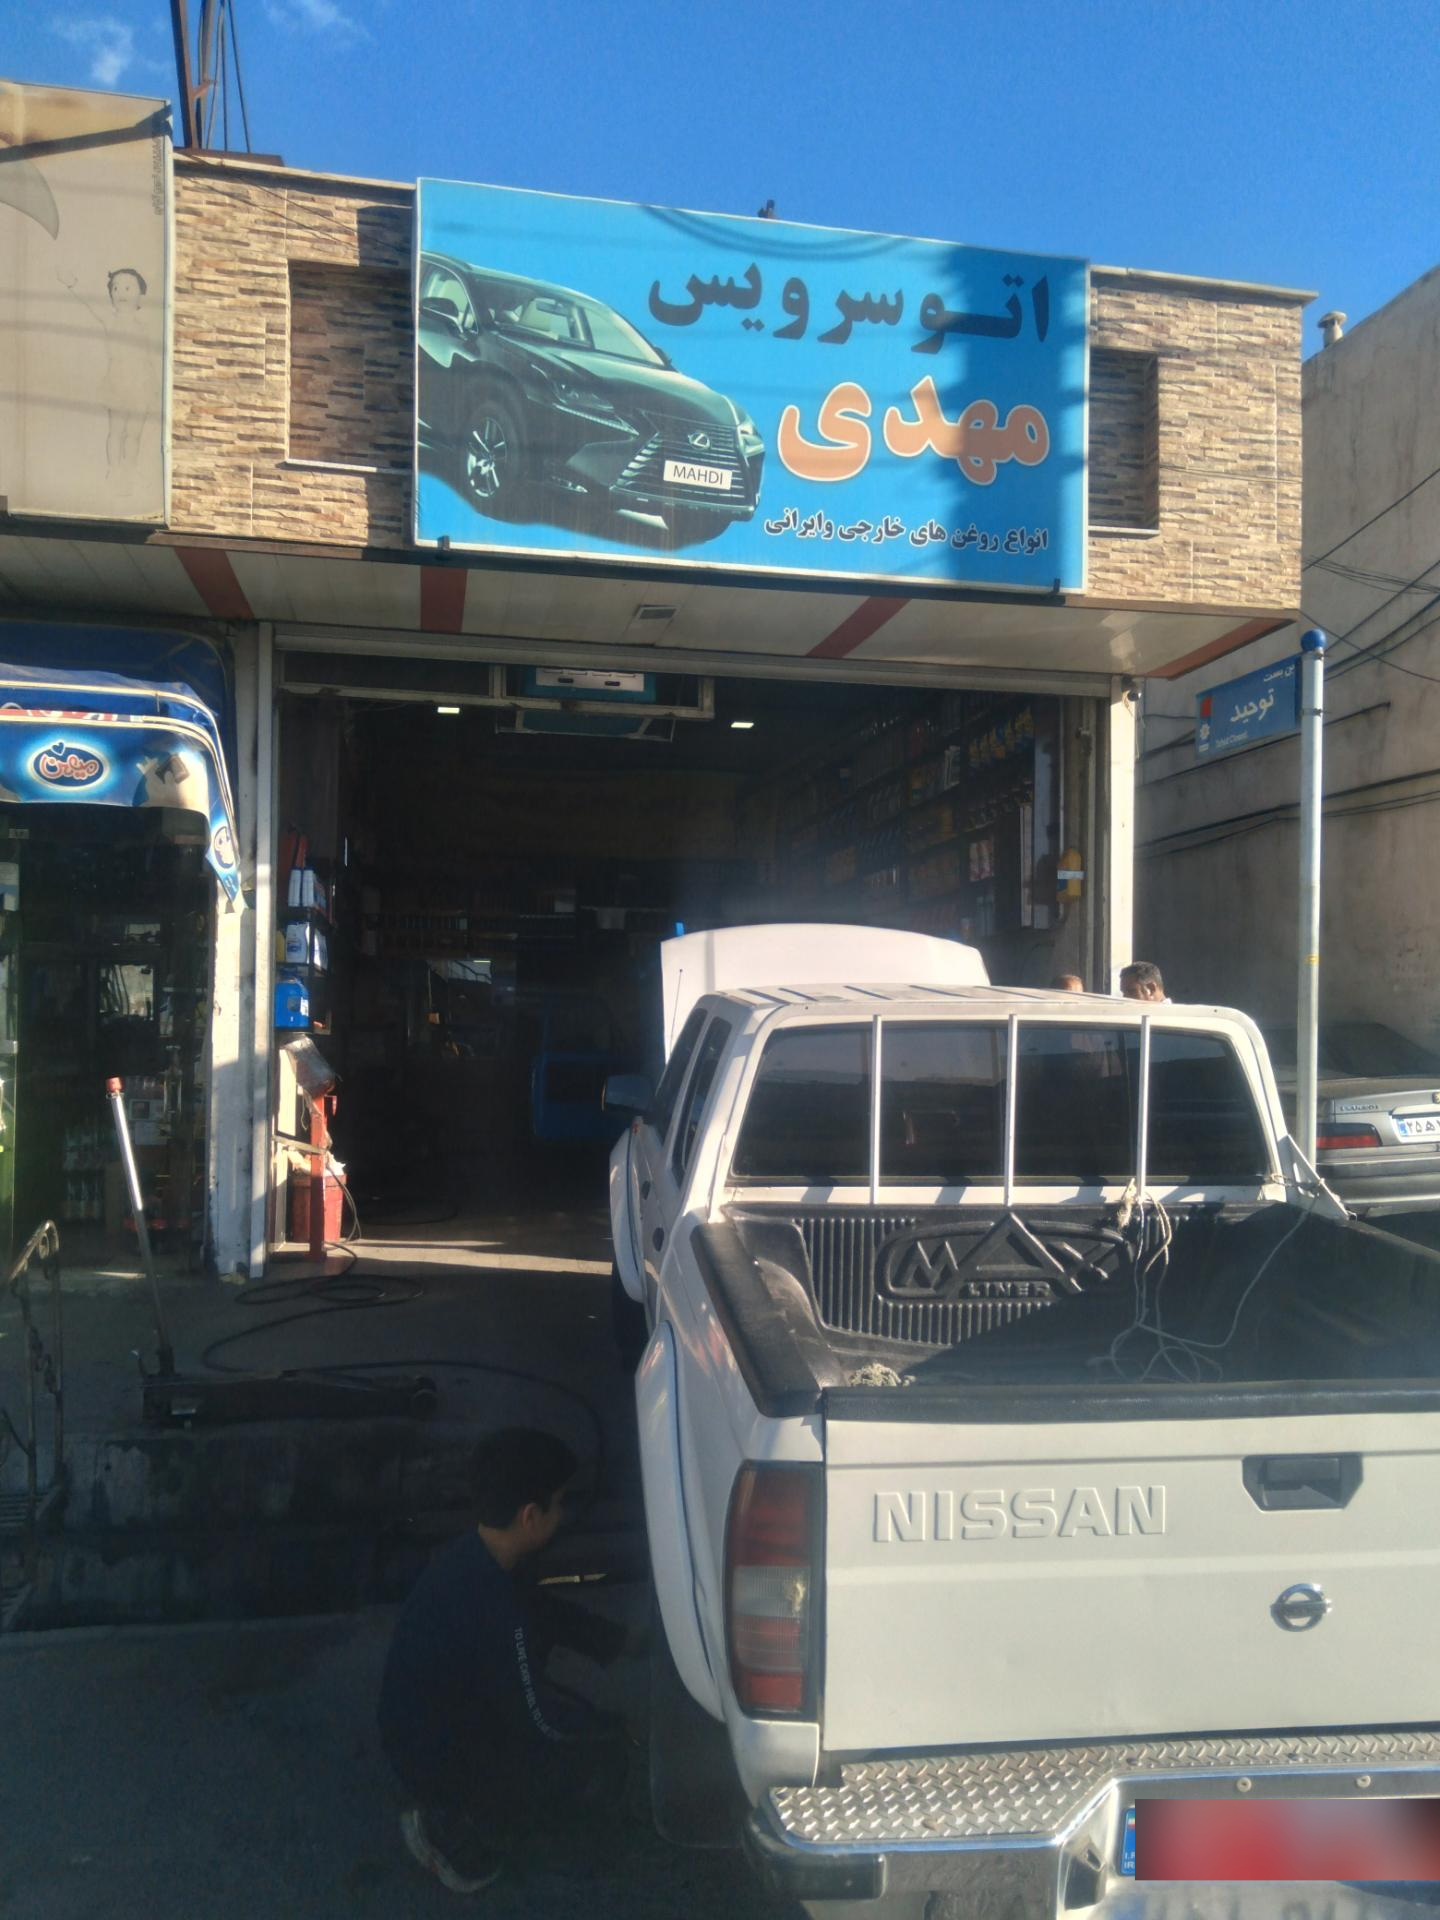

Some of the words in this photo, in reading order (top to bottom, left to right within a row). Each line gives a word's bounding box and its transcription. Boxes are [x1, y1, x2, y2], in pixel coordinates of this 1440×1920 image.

[777, 375, 1050, 486] مهدی
[673, 465, 723, 485] MAHDI
[838, 515, 905, 544] خارجی
[909, 519, 948, 546] های
[951, 523, 1000, 552] روغن
[1003, 527, 1049, 555] انواع
[1230, 688, 1275, 723] توحید
[967, 1281, 1050, 1297] LINER
[873, 1485, 1168, 1543] NISSAN
